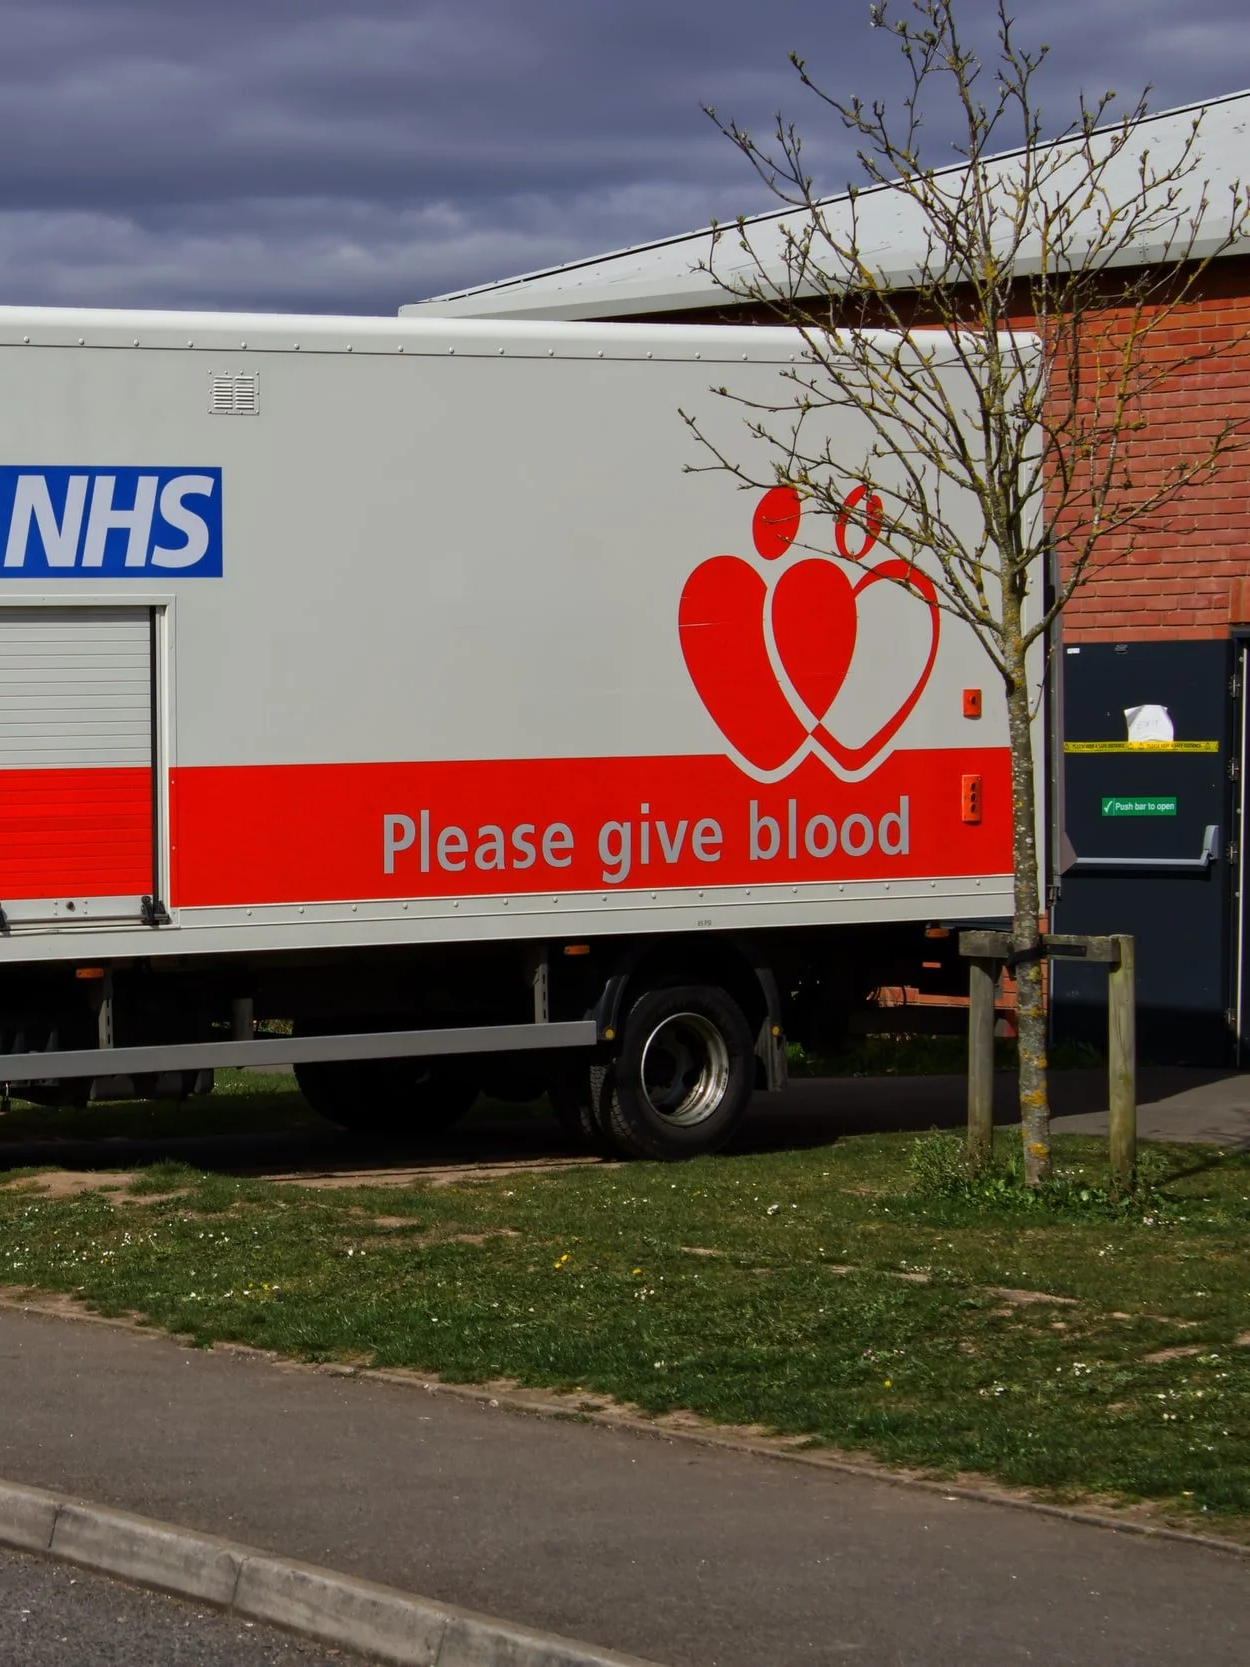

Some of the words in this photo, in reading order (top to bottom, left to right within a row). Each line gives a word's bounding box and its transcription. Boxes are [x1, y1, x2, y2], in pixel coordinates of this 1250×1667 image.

[4, 475, 214, 568] NHS
[383, 809, 574, 874] Please
[598, 801, 723, 884] give
[749, 795, 910, 861] blood
[1115, 802, 1133, 811] Push
[1134, 802, 1146, 811] bar
[1148, 802, 1155, 810] to
[1156, 803, 1175, 812] open
